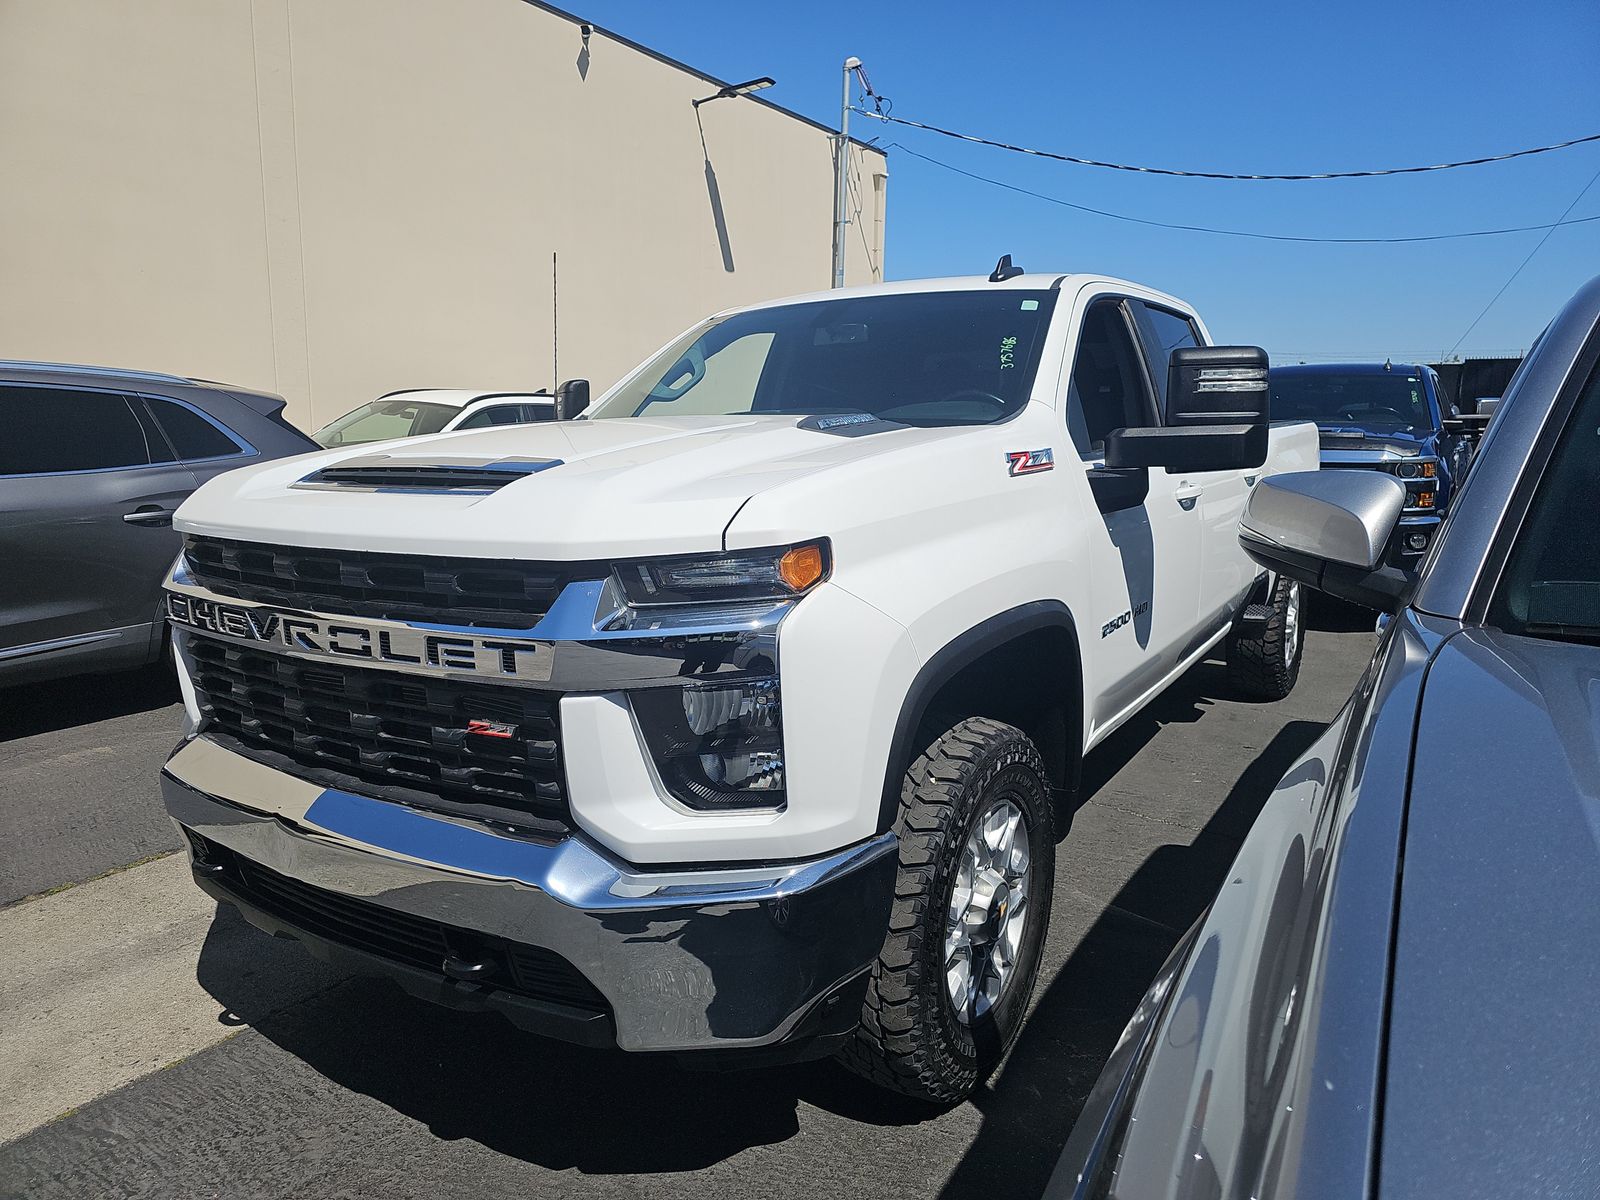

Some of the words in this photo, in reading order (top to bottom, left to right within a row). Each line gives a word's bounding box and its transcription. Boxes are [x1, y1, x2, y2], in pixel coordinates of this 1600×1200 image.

[1004, 448, 1054, 477] Z71
[166, 592, 536, 675] CHEVROLET
[1102, 610, 1131, 639] 2500
[1133, 601, 1148, 618] HD
